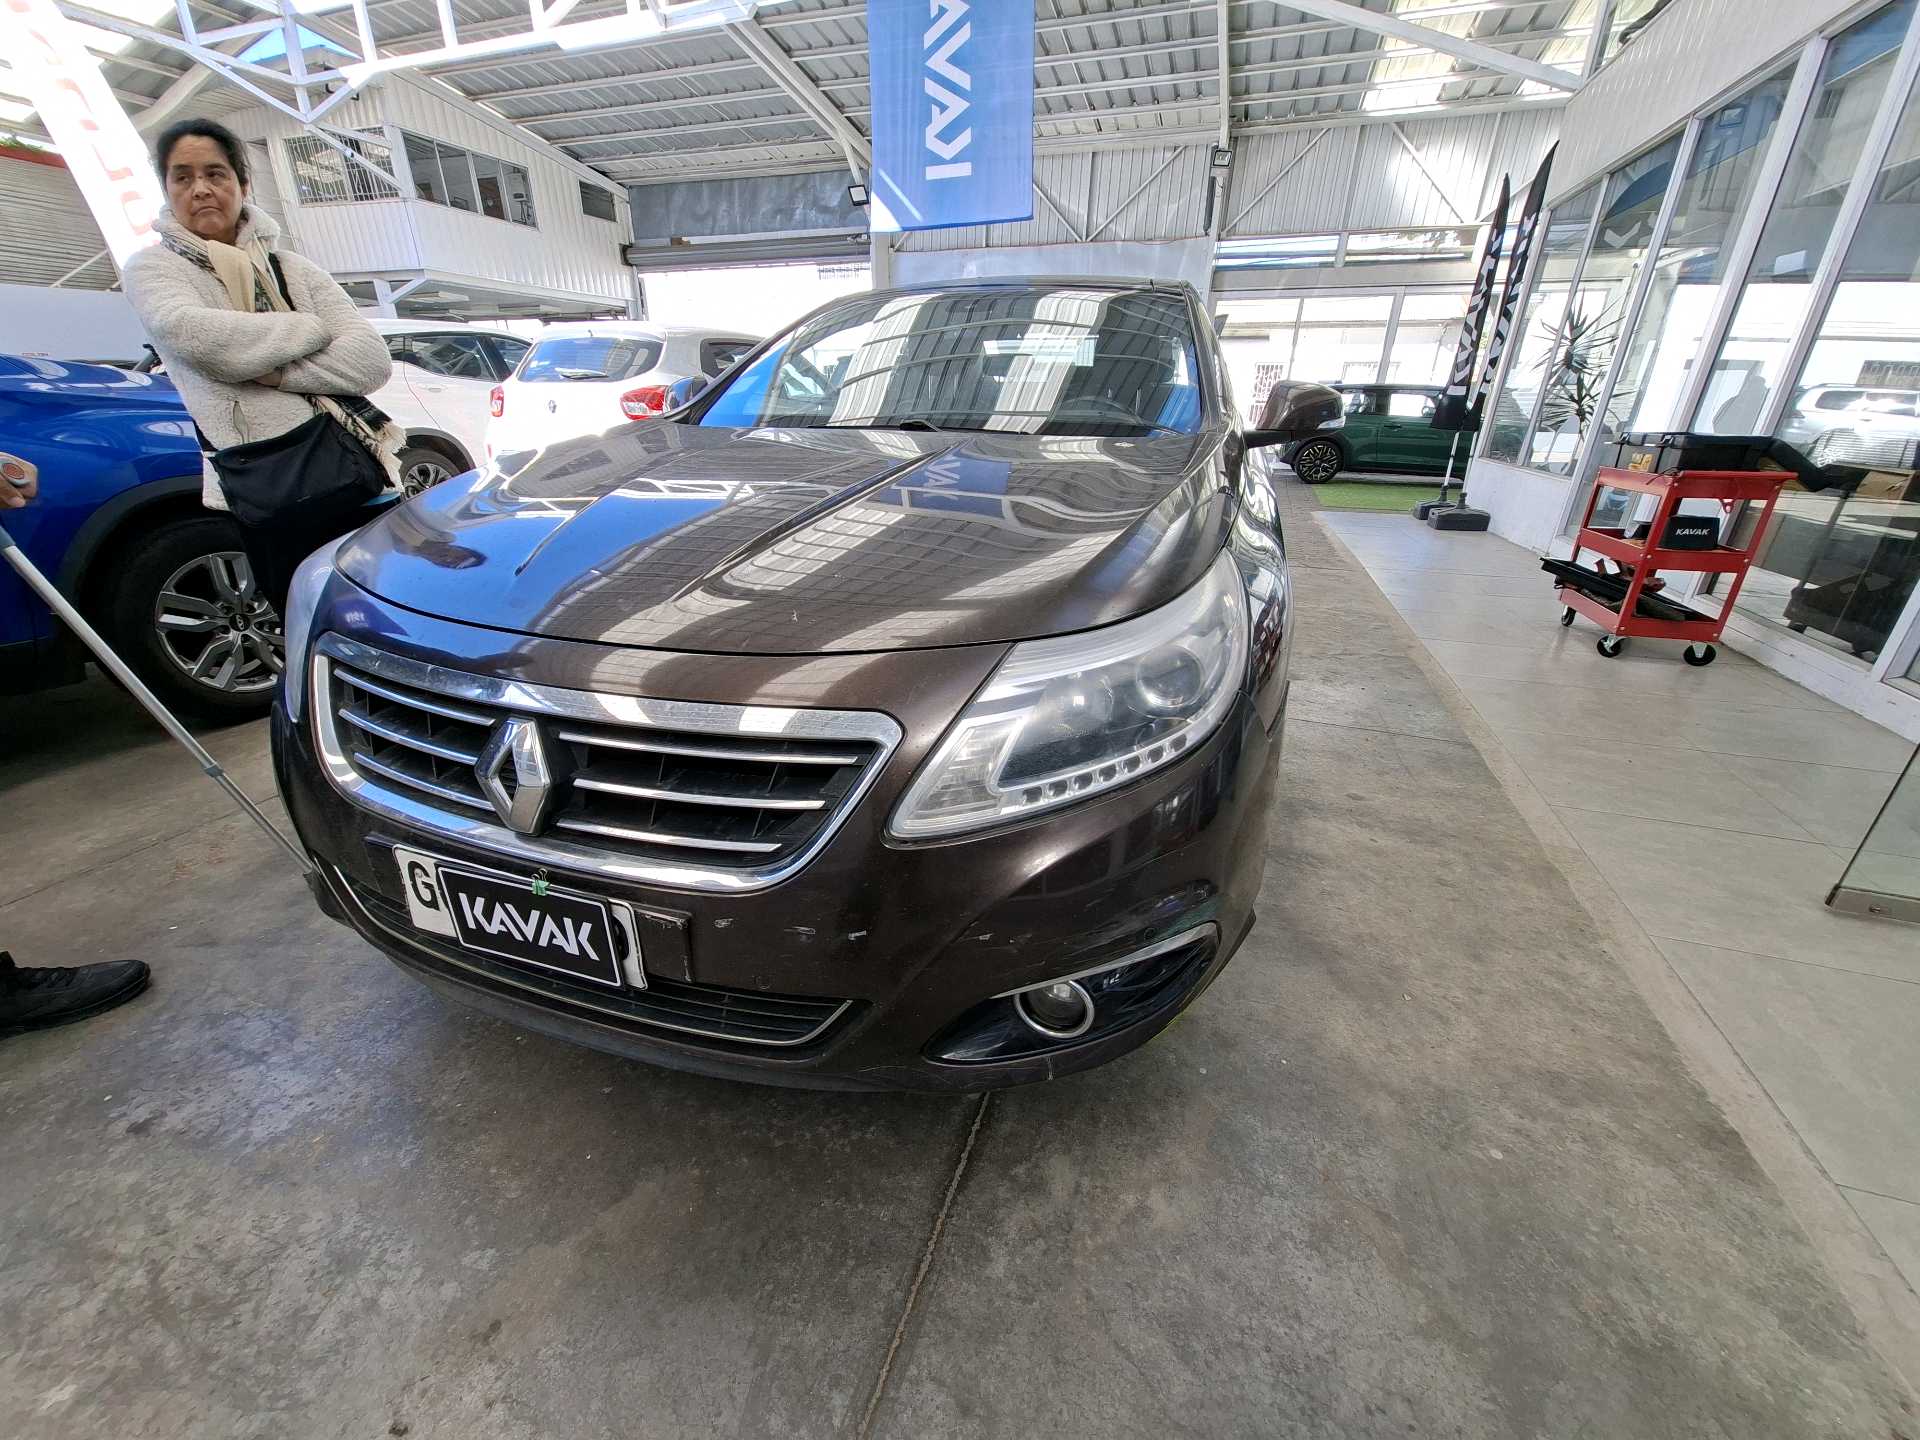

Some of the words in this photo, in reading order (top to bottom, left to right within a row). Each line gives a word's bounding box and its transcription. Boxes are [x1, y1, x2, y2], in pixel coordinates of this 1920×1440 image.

[1675, 528, 1710, 536] KAVAK
[407, 860, 451, 911] G
[458, 892, 600, 961] KAVAK
